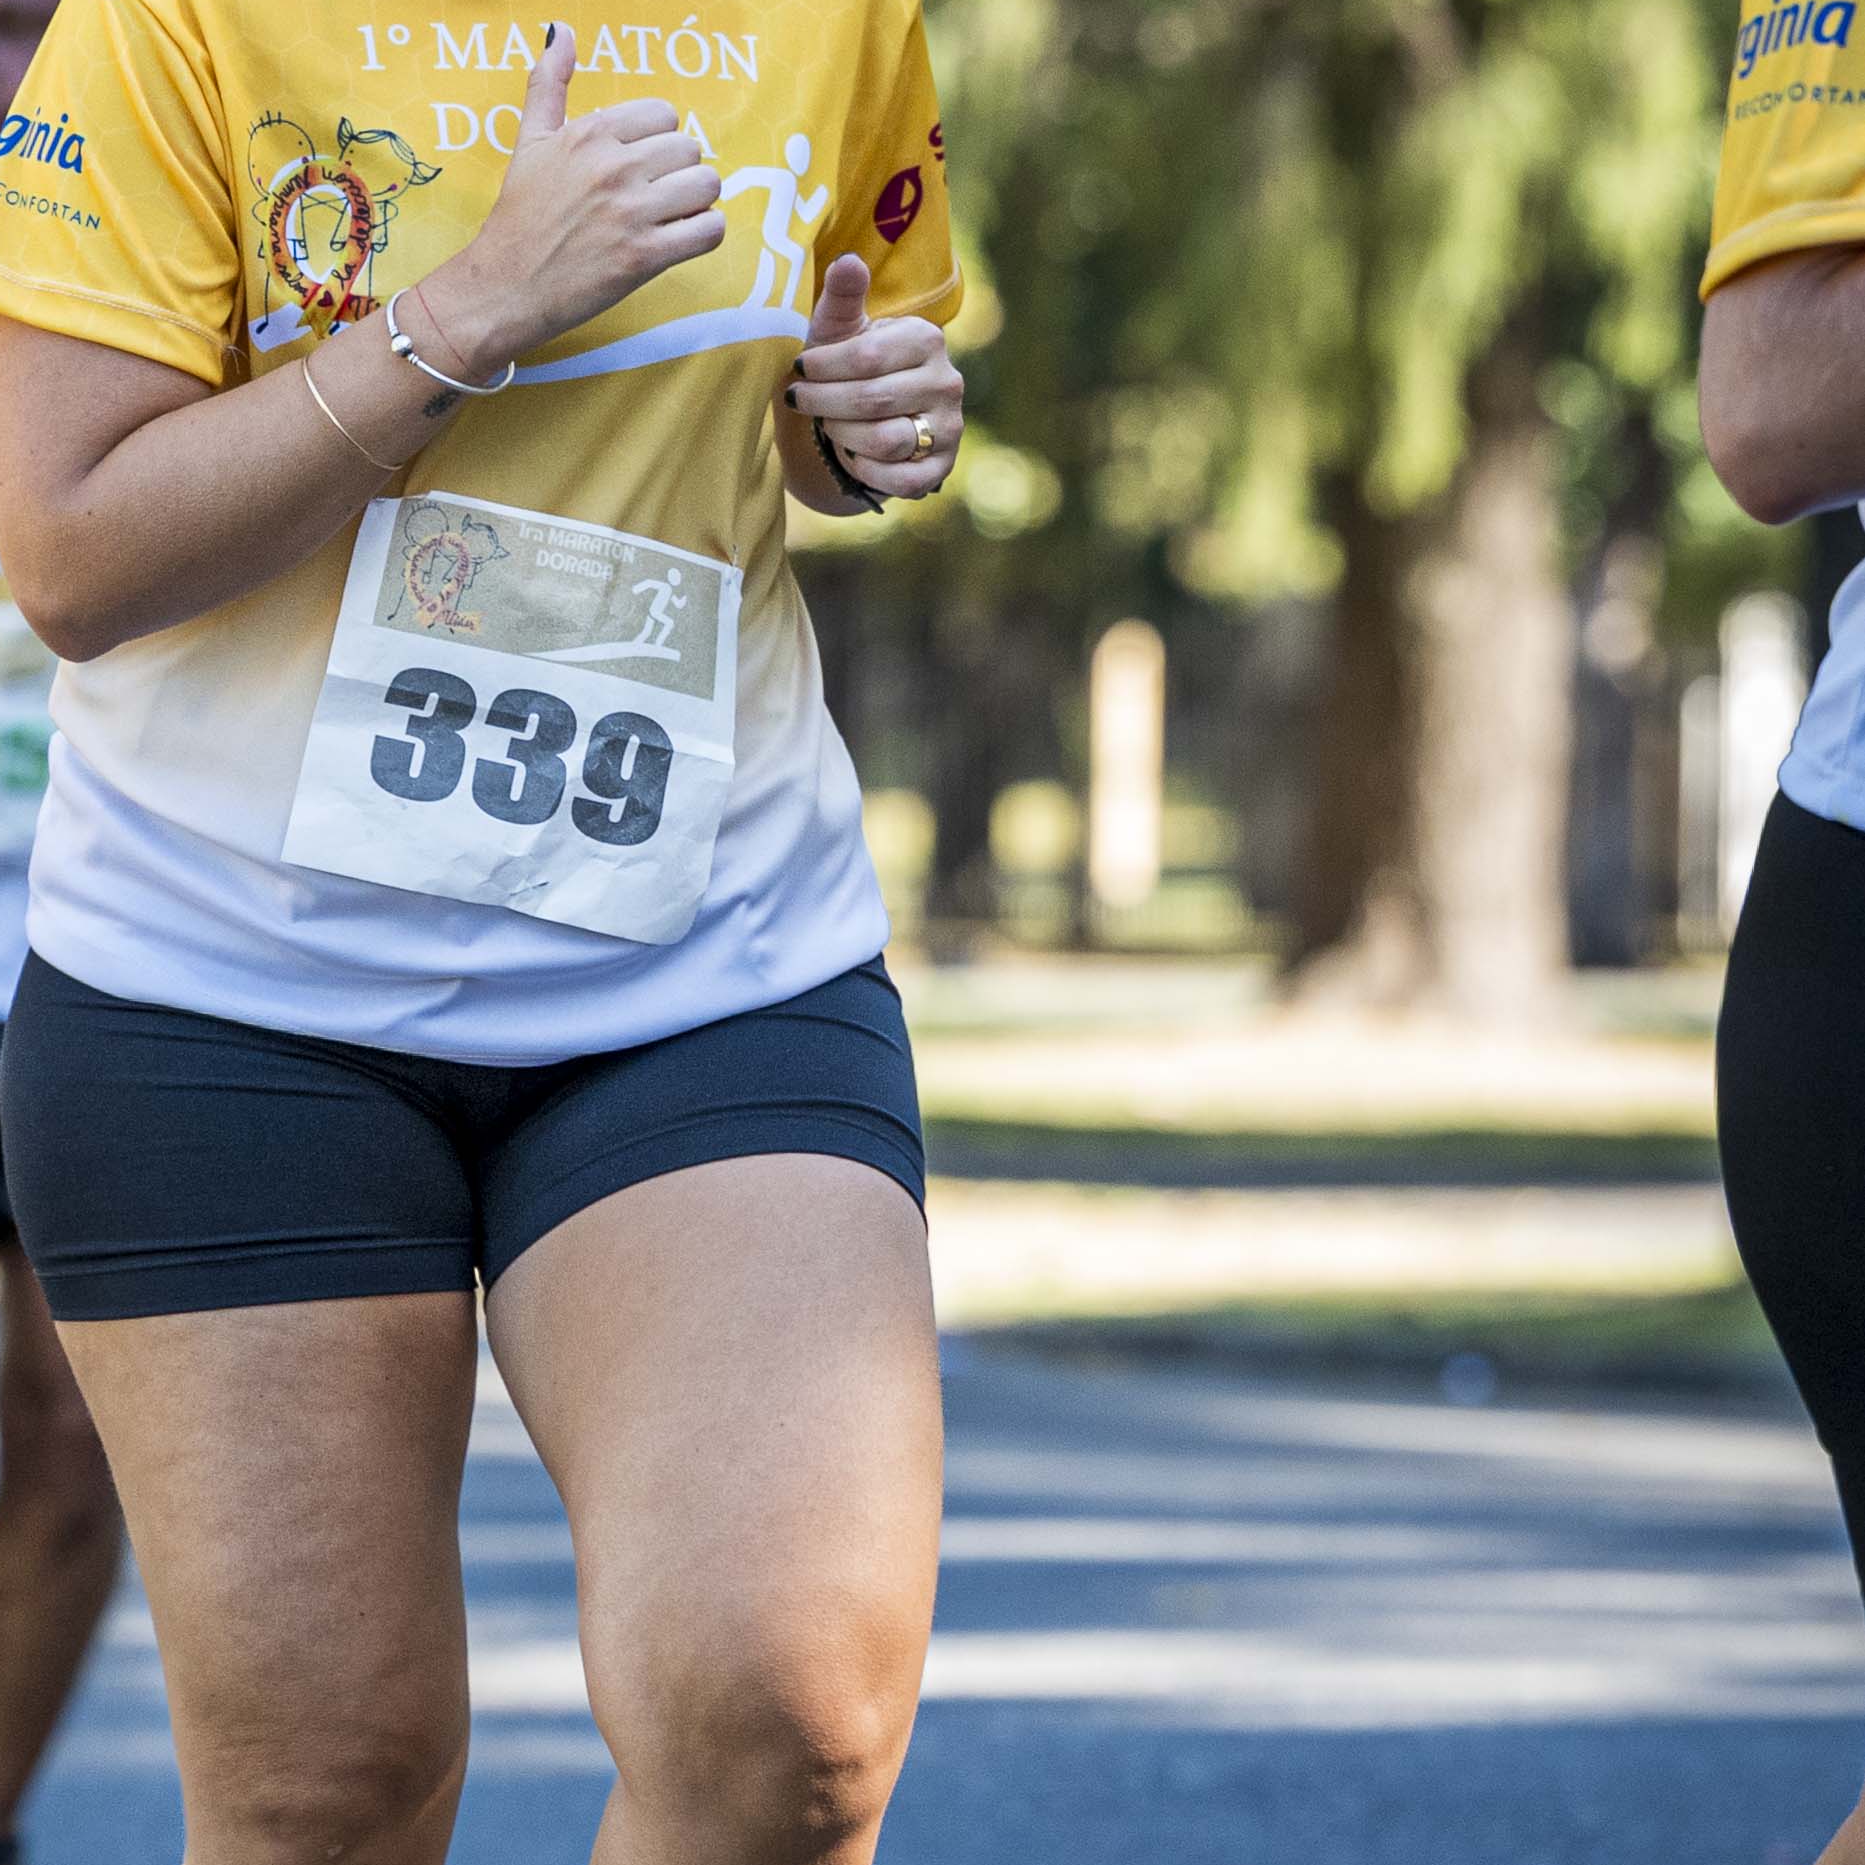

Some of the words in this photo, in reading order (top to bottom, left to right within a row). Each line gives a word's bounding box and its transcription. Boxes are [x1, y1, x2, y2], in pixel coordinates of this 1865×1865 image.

[1735, 81, 1865, 121] RECONORTA
[430, 102, 719, 161] DOA
[370, 667, 674, 847] 339
